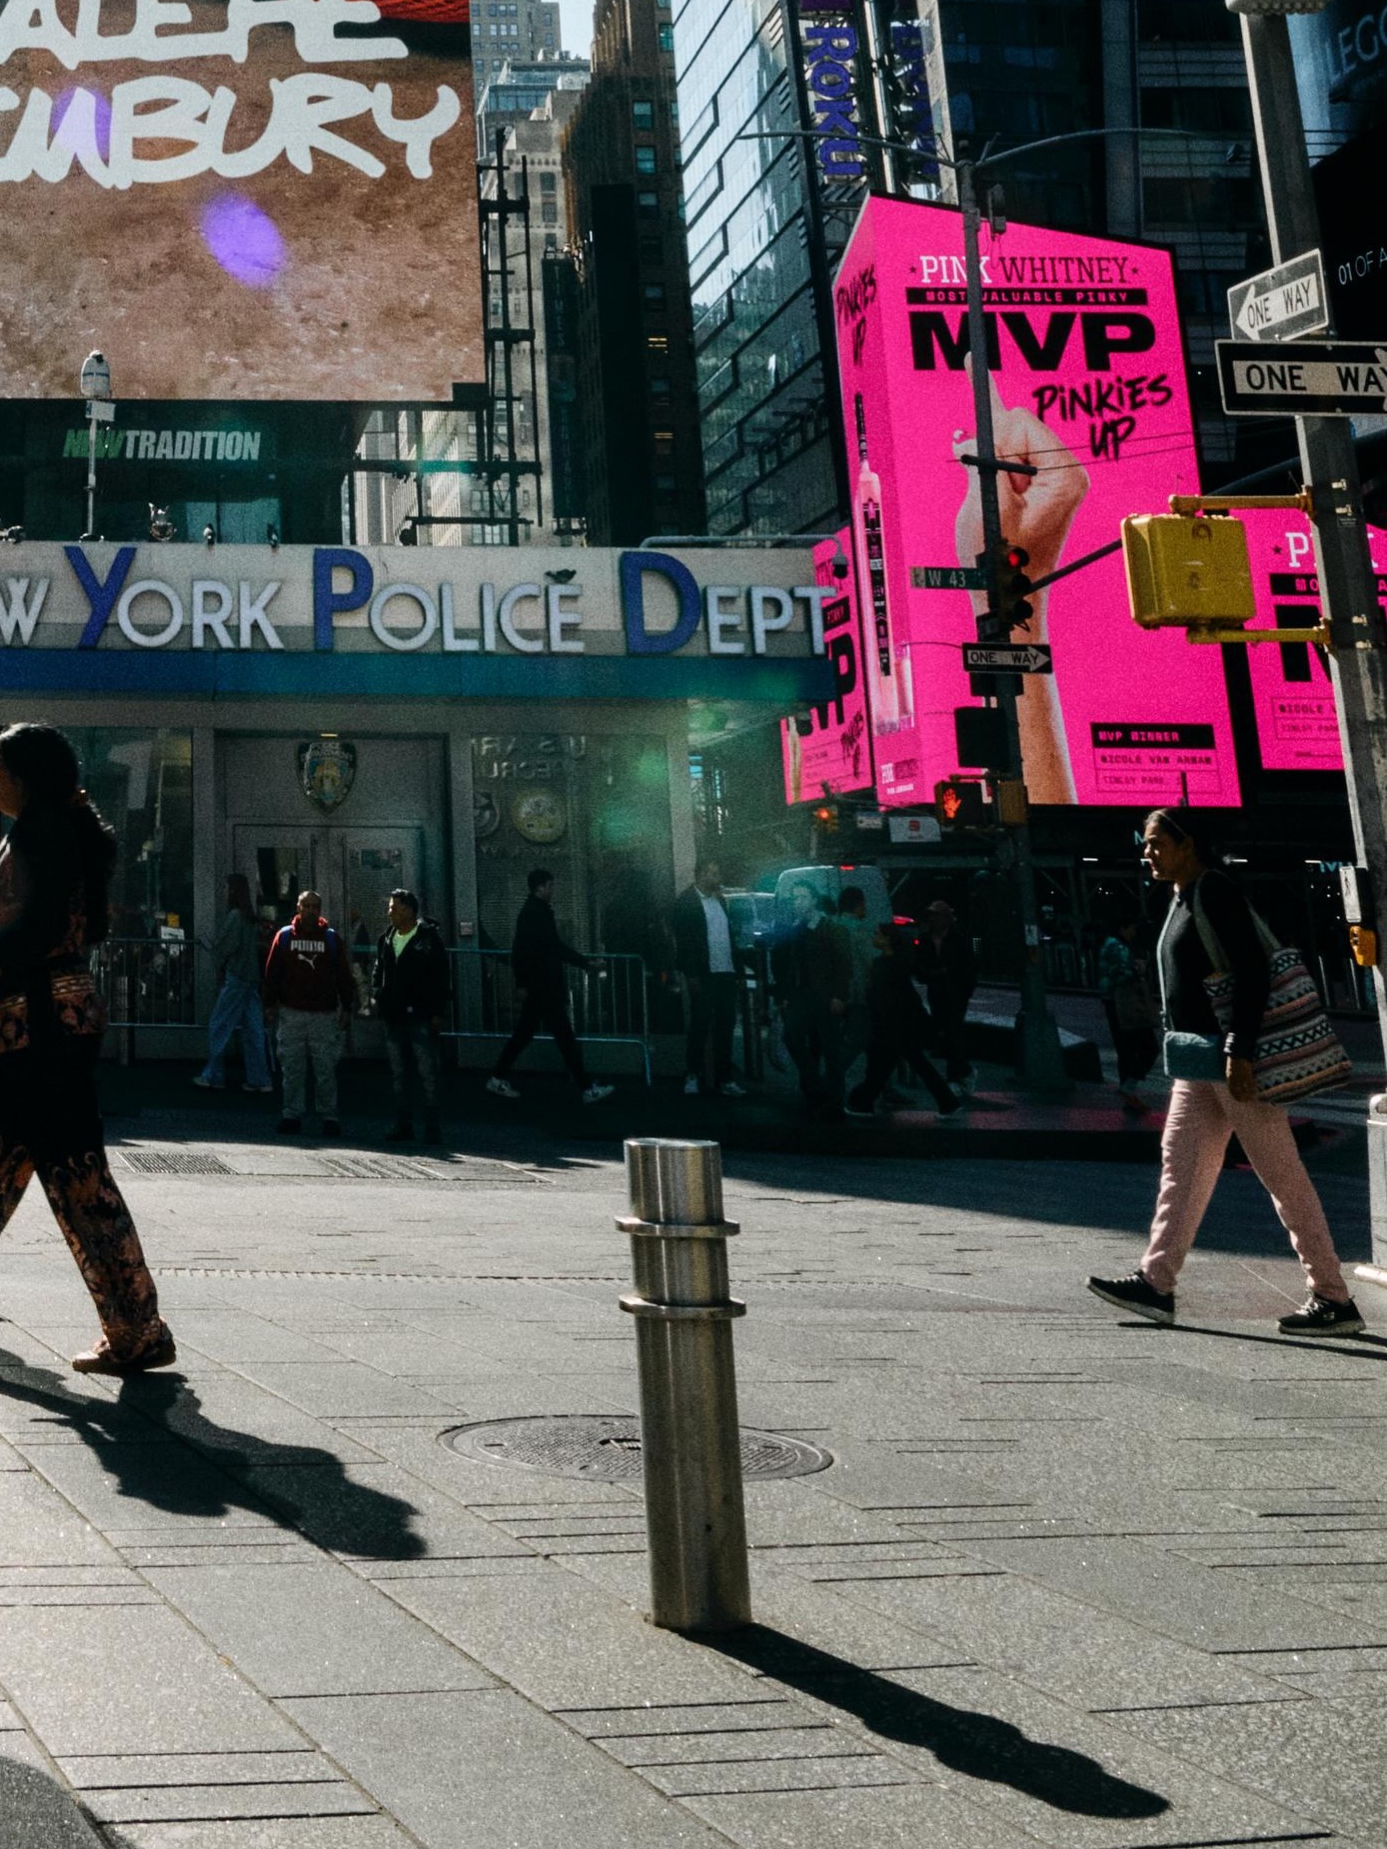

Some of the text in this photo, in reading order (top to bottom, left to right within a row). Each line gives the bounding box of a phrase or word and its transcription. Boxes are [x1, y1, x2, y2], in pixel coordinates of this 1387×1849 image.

[998, 256, 1128, 284] WHITNEY
[1355, 251, 1374, 277] OF
[926, 291, 966, 302] MOST
[1076, 292, 1128, 302] PINKY
[1247, 279, 1313, 329] ONE WAY
[909, 311, 1156, 371] MVP
[1245, 364, 1307, 392] ONE
[1089, 415, 1136, 461] UP
[928, 570, 942, 586] W
[949, 571, 966, 588] 43
[63, 545, 285, 650] YORK
[314, 547, 585, 653] POLICE
[620, 551, 838, 654] DEPT
[970, 653, 1040, 665] ONE WAY
[290, 939, 325, 953] PUMA
